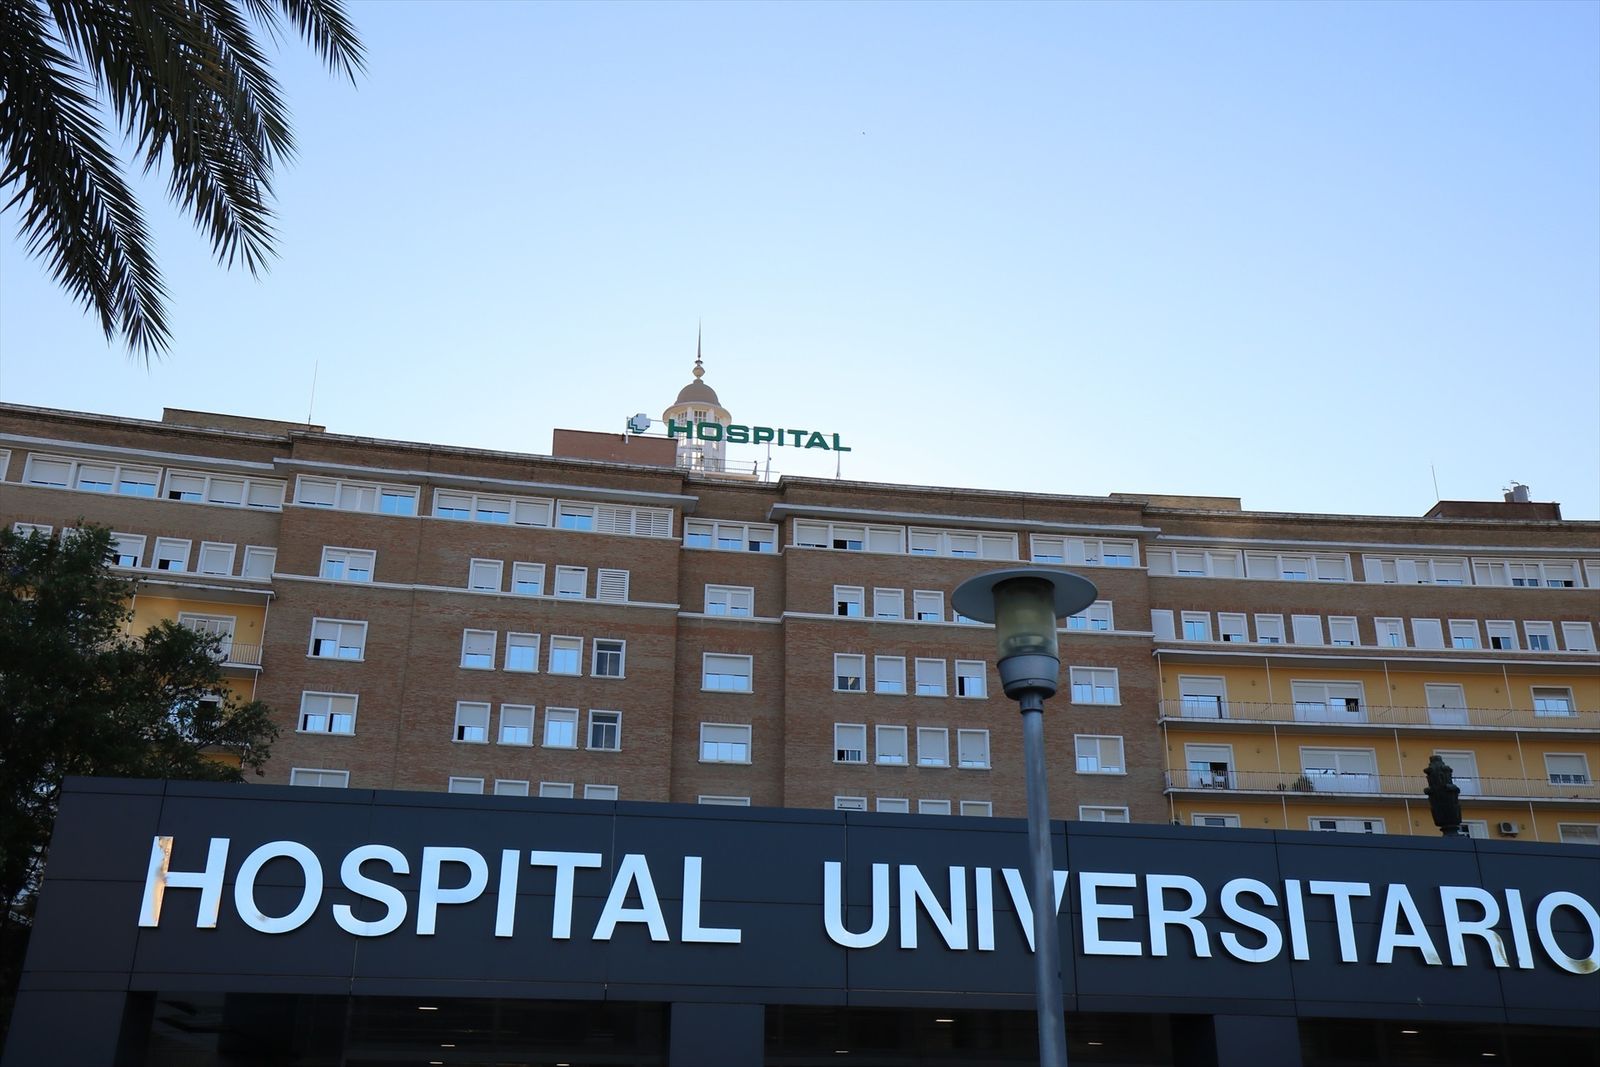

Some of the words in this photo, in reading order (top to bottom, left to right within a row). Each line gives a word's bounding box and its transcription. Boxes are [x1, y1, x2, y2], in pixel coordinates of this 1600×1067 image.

[667, 418, 852, 452] HOSPITAL
[137, 835, 742, 944] HOSPITAL
[823, 861, 1600, 975] UNIVERSITARIO
